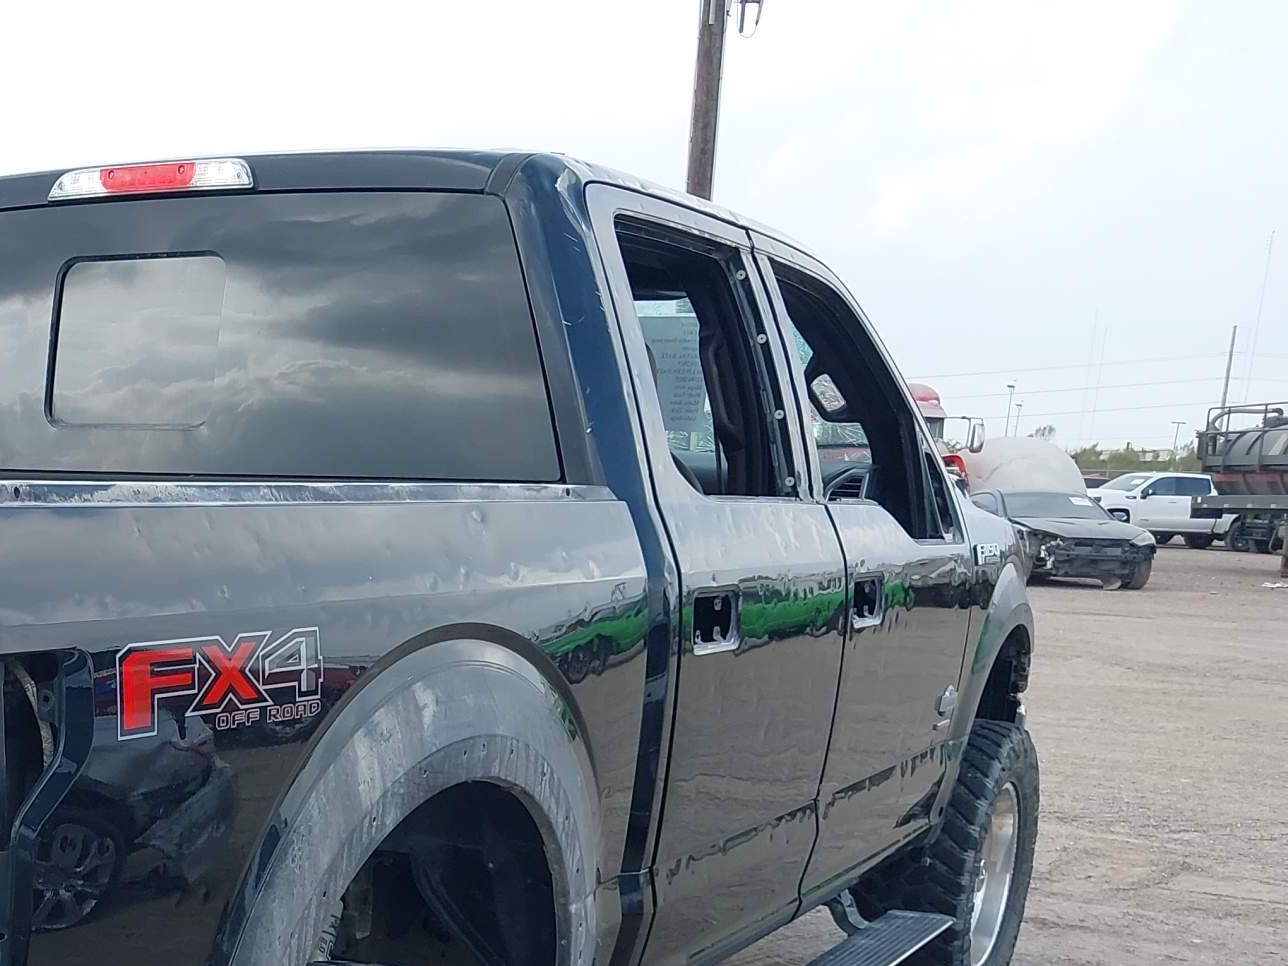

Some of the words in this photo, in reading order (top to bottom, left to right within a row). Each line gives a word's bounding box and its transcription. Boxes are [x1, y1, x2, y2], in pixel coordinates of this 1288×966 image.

[116, 626, 324, 742] FX4
[215, 708, 261, 730] OFF
[266, 700, 322, 724] ROAD
